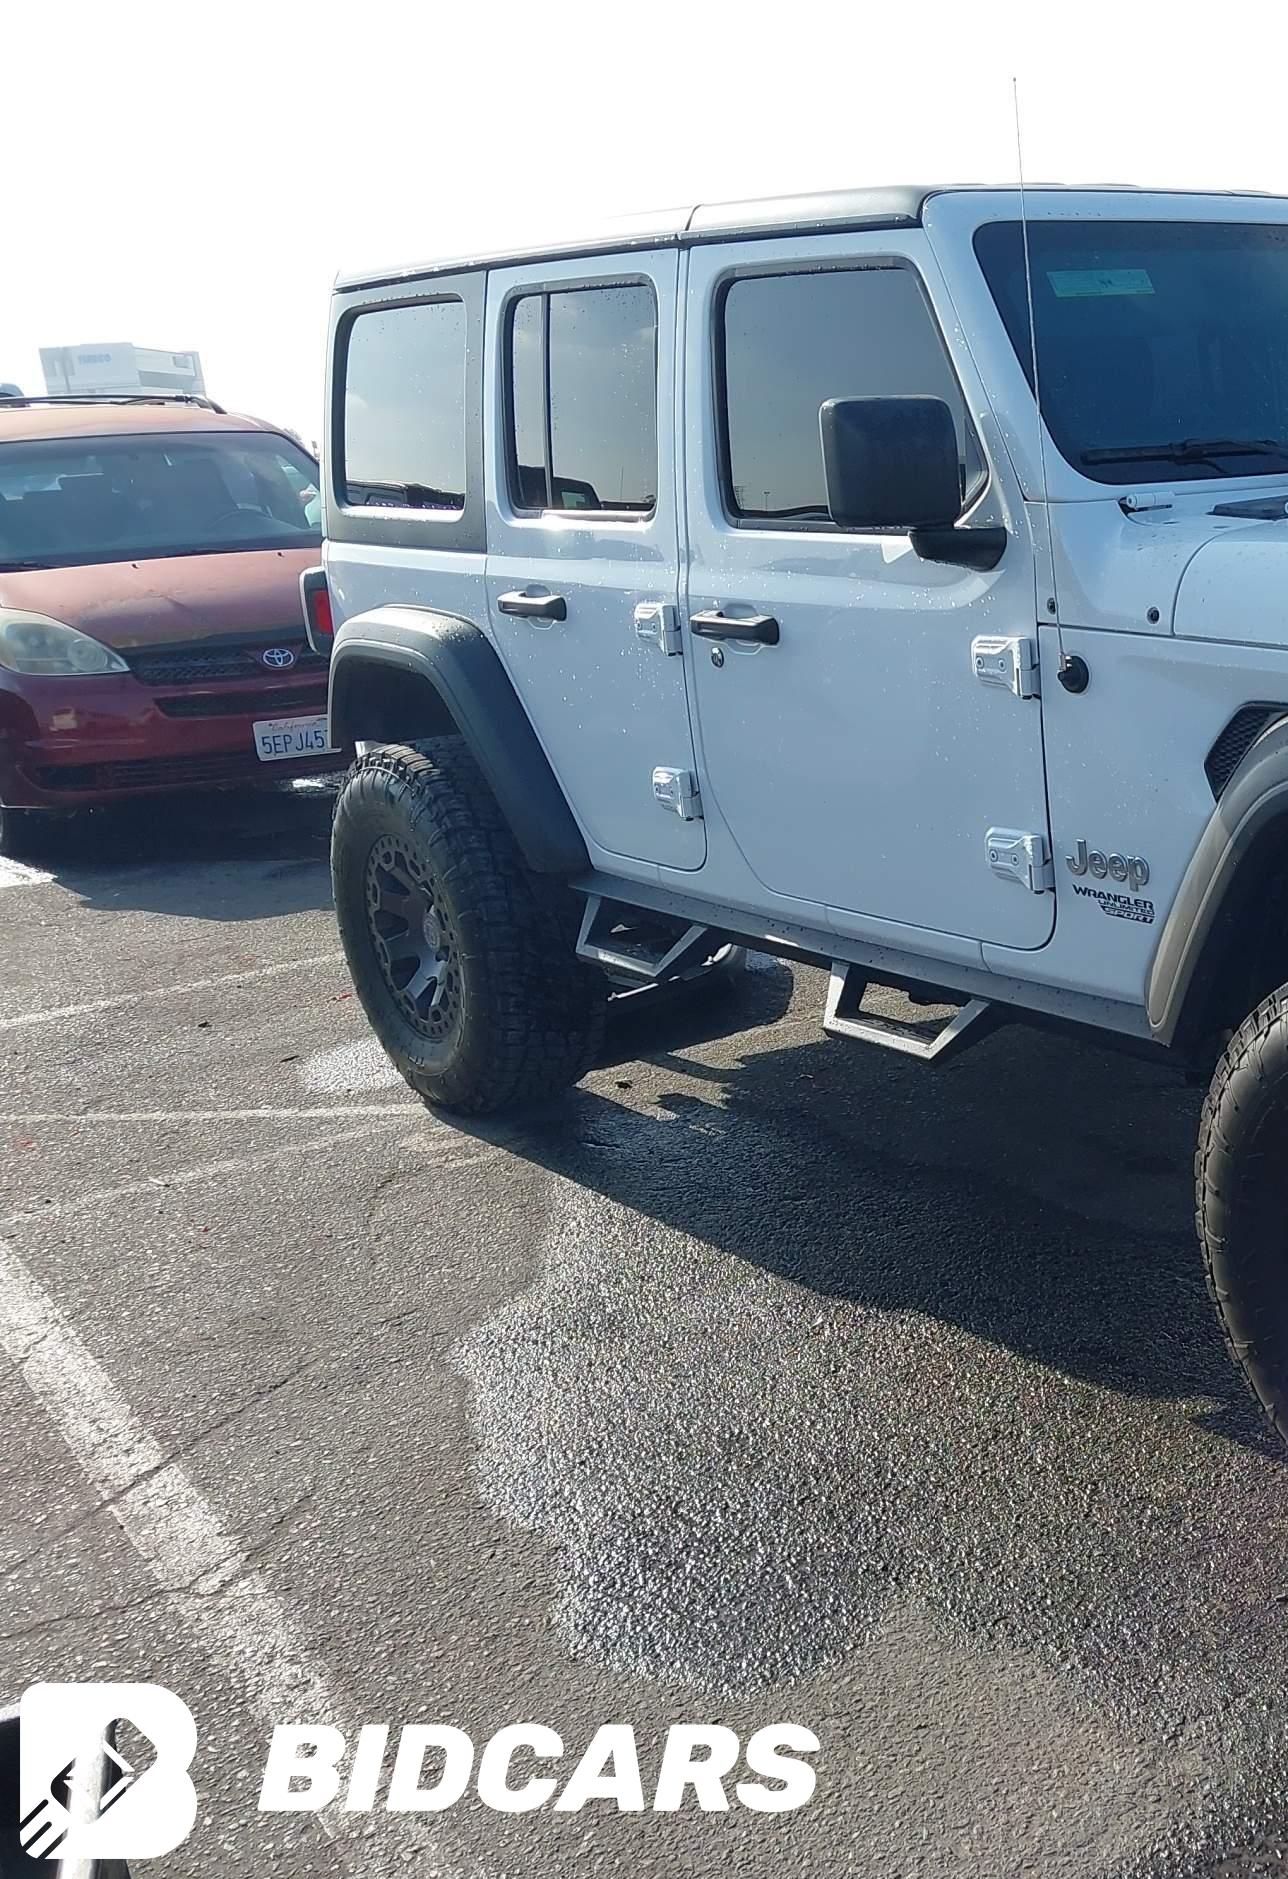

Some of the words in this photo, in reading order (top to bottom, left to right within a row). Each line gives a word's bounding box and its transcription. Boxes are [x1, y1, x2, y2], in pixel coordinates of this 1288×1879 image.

[261, 729, 328, 754] 5EPJ45
[1065, 839, 1149, 892] Jeep
[1072, 884, 1154, 910] WRANGLER
[1098, 900, 1155, 915] UNLIMITED
[1104, 907, 1154, 924] SPORT
